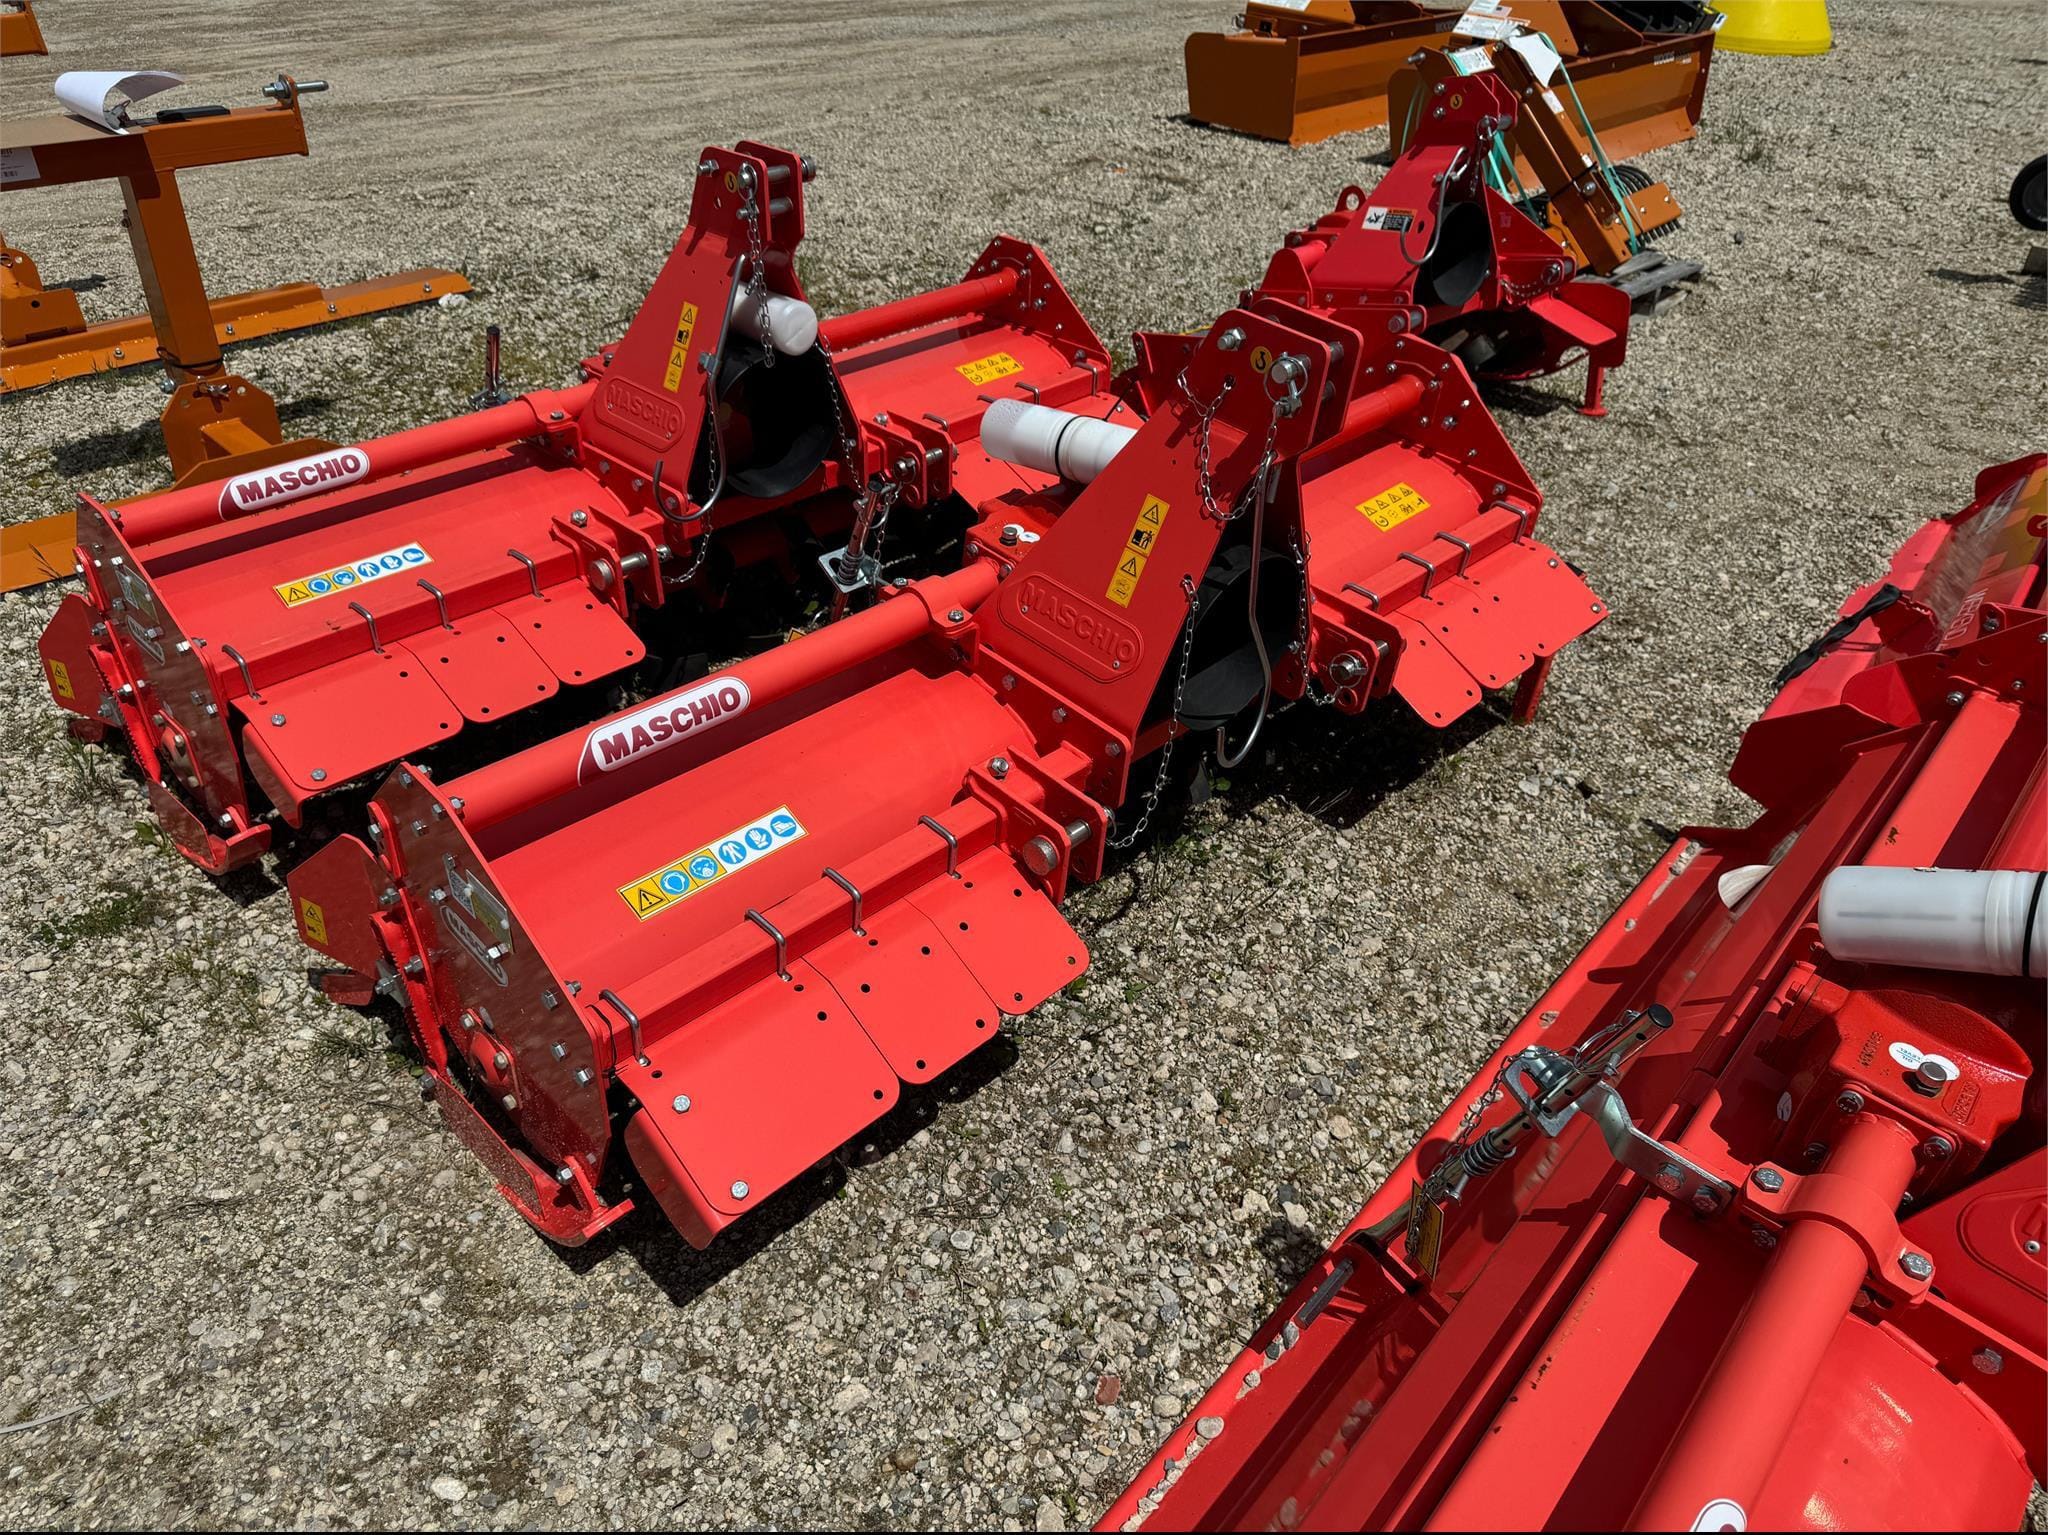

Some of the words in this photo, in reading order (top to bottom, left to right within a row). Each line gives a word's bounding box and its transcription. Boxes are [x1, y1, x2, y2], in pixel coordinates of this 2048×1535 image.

[606, 383, 680, 433] MASCHIO
[236, 454, 361, 504] MASCHIO
[1020, 581, 1136, 663] MASCHIO
[598, 686, 741, 765] MASCHIO
